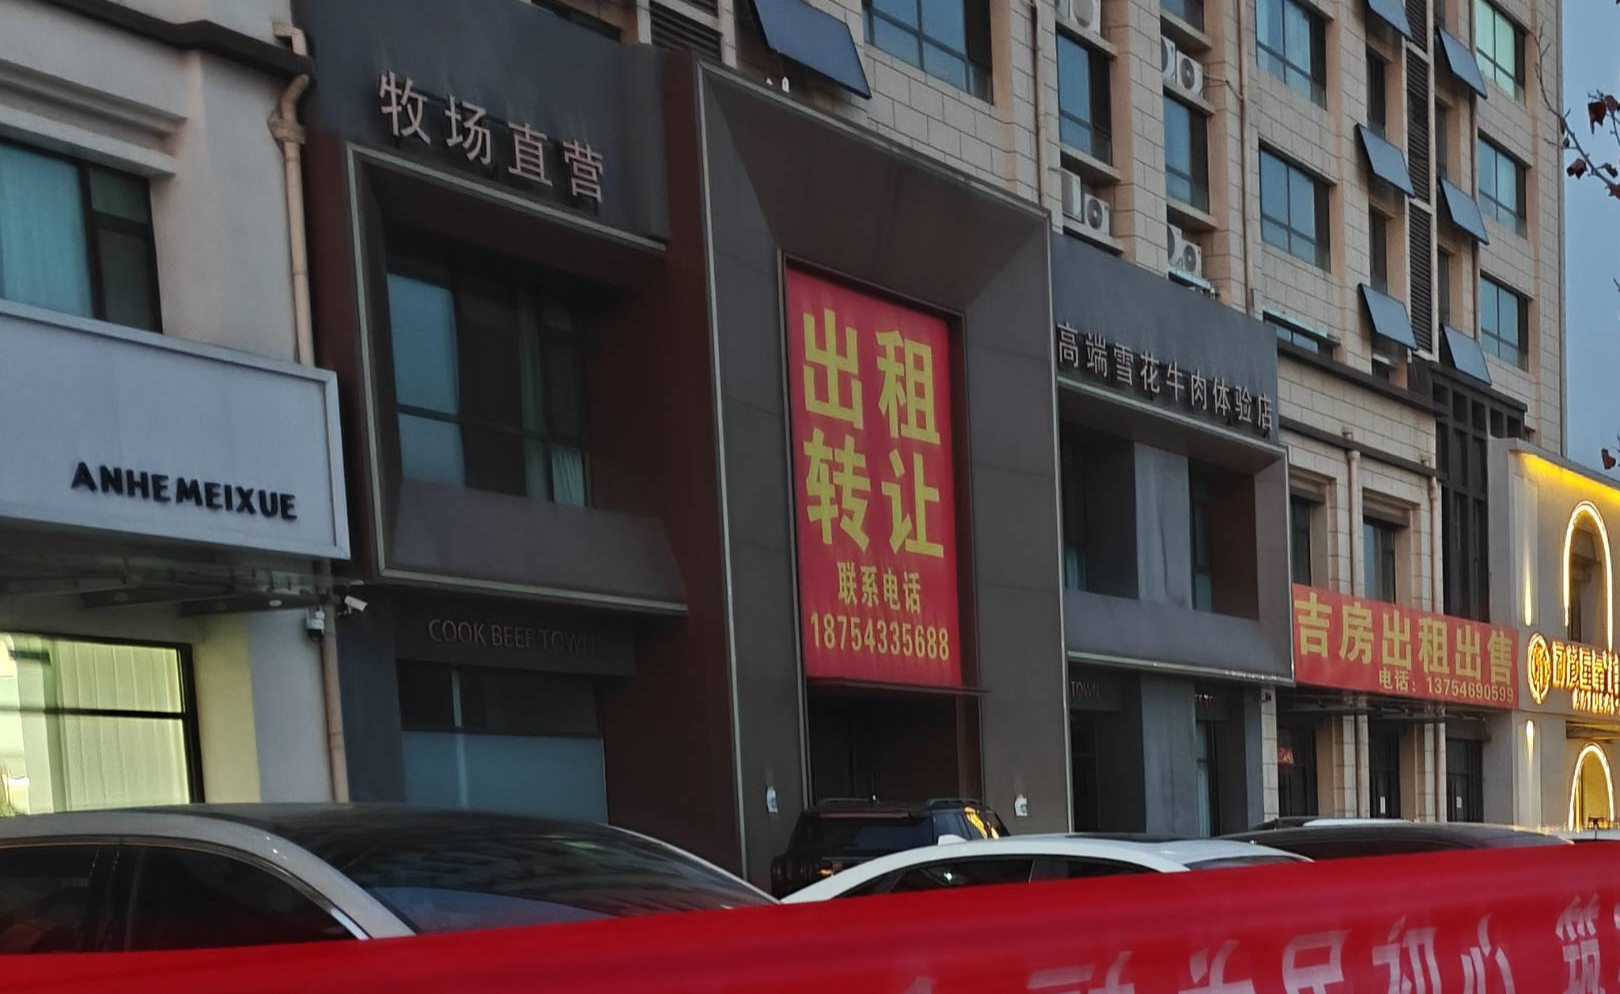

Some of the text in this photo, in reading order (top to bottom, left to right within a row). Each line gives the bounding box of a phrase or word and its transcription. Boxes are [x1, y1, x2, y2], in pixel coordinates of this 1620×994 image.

[379, 70, 604, 203] 牧场直营
[803, 308, 941, 446] 出租
[1057, 322, 1273, 431] 高端雪花牛肉体验店
[803, 428, 944, 558] 转让
[428, 618, 487, 646] COOK
[490, 622, 535, 650] BEEF
[837, 561, 921, 614] 联系电话
[811, 612, 949, 661] 18754335688
[1294, 591, 1513, 685] 吉房出租出售
[1425, 676, 1514, 704] 13754690599
